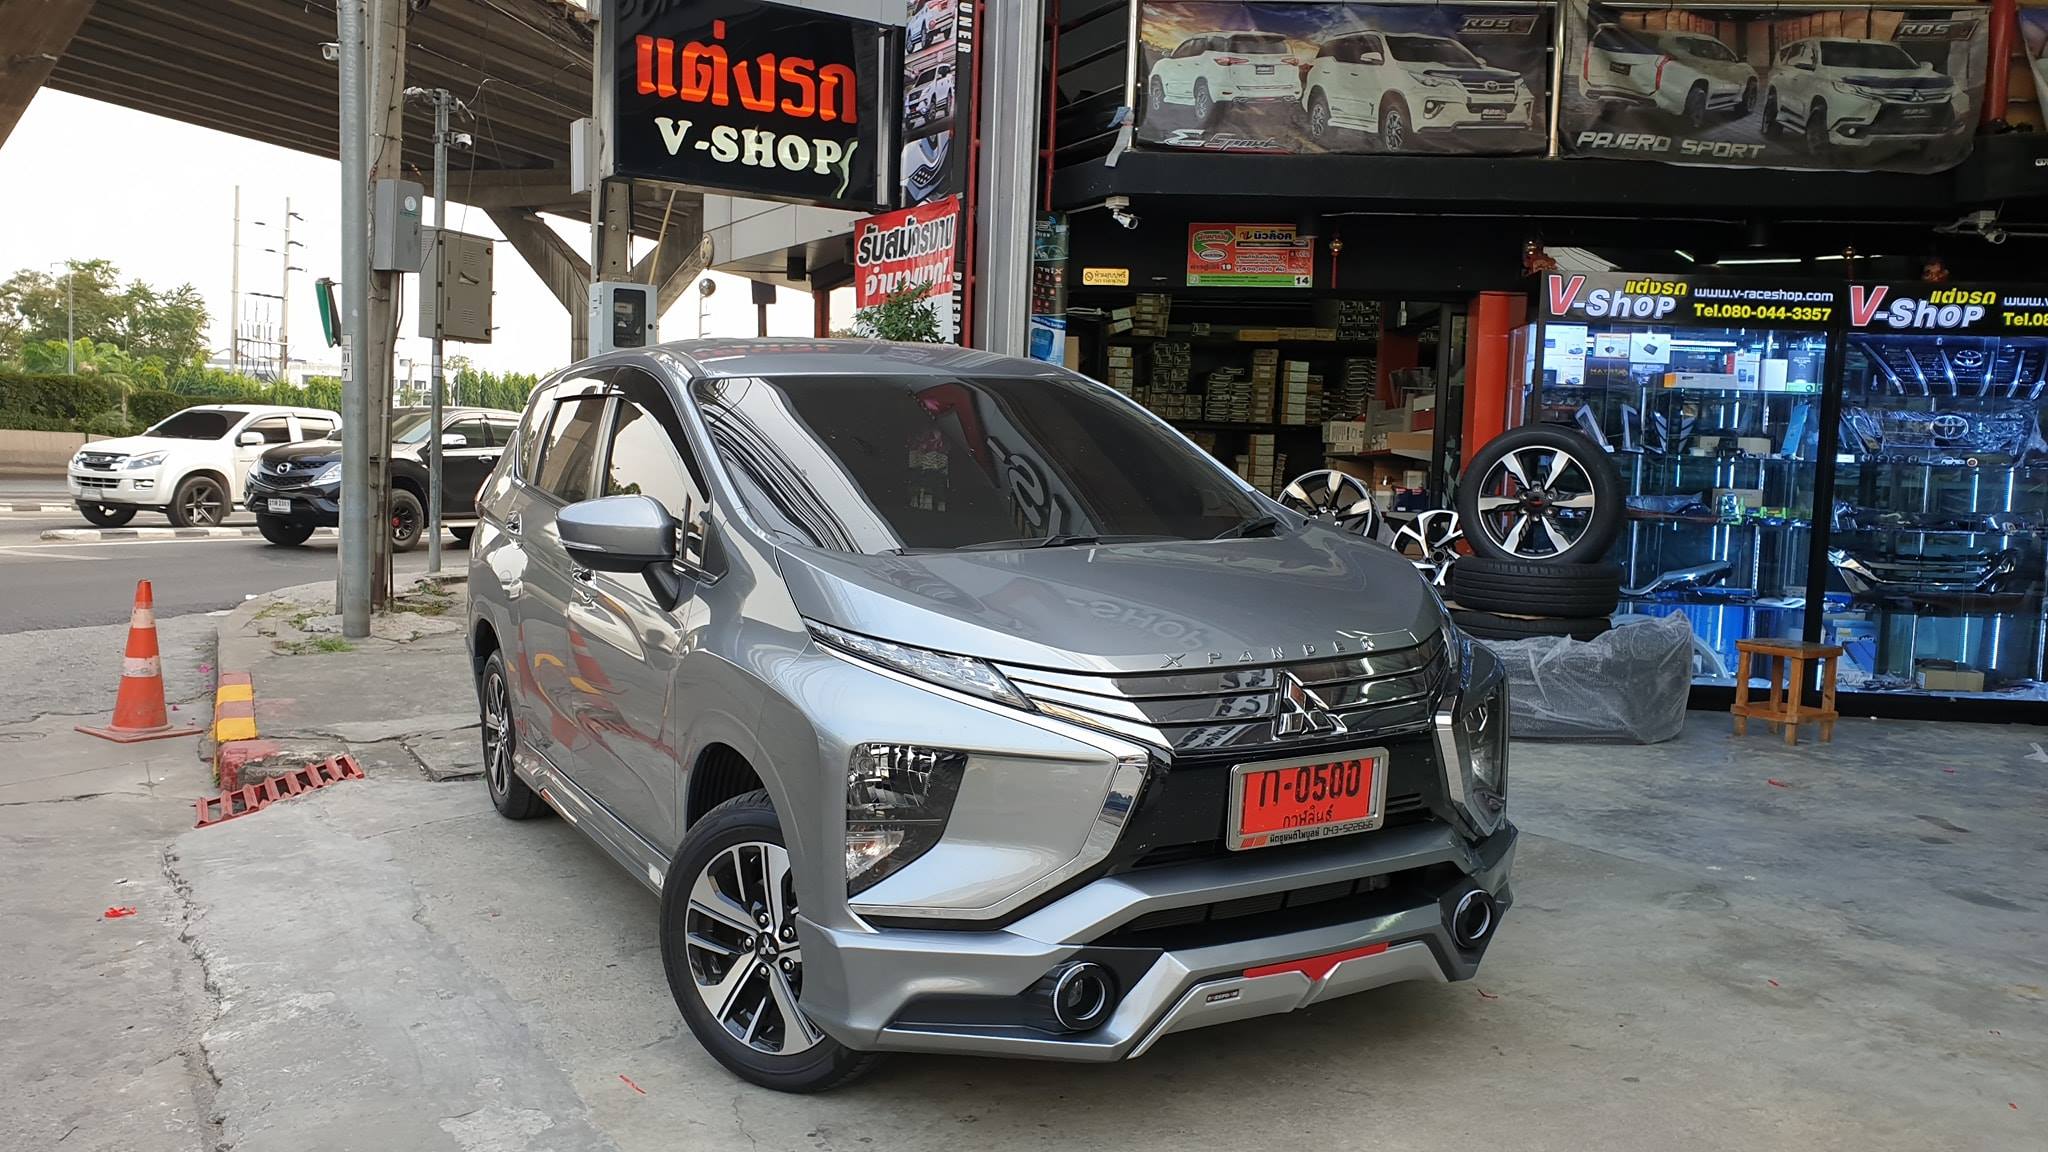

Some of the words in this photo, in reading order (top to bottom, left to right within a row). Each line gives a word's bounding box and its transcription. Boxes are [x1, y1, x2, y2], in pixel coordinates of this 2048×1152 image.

[636, 20, 858, 124] แต่งรถ
[654, 117, 842, 175] V-SHOP
[1576, 131, 1671, 151] PAJERO
[1680, 139, 1765, 158] SPORT
[857, 213, 956, 267] รับสมัครงาน
[1296, 276, 1309, 285] 14
[1624, 277, 1688, 296] แต่งรถ
[1694, 288, 1834, 302] www.v-raceshop.com
[1930, 288, 1997, 305] แต่งรถ
[1693, 303, 1832, 321] Tel.080-044-3357
[1160, 635, 1375, 668] XPANDER
